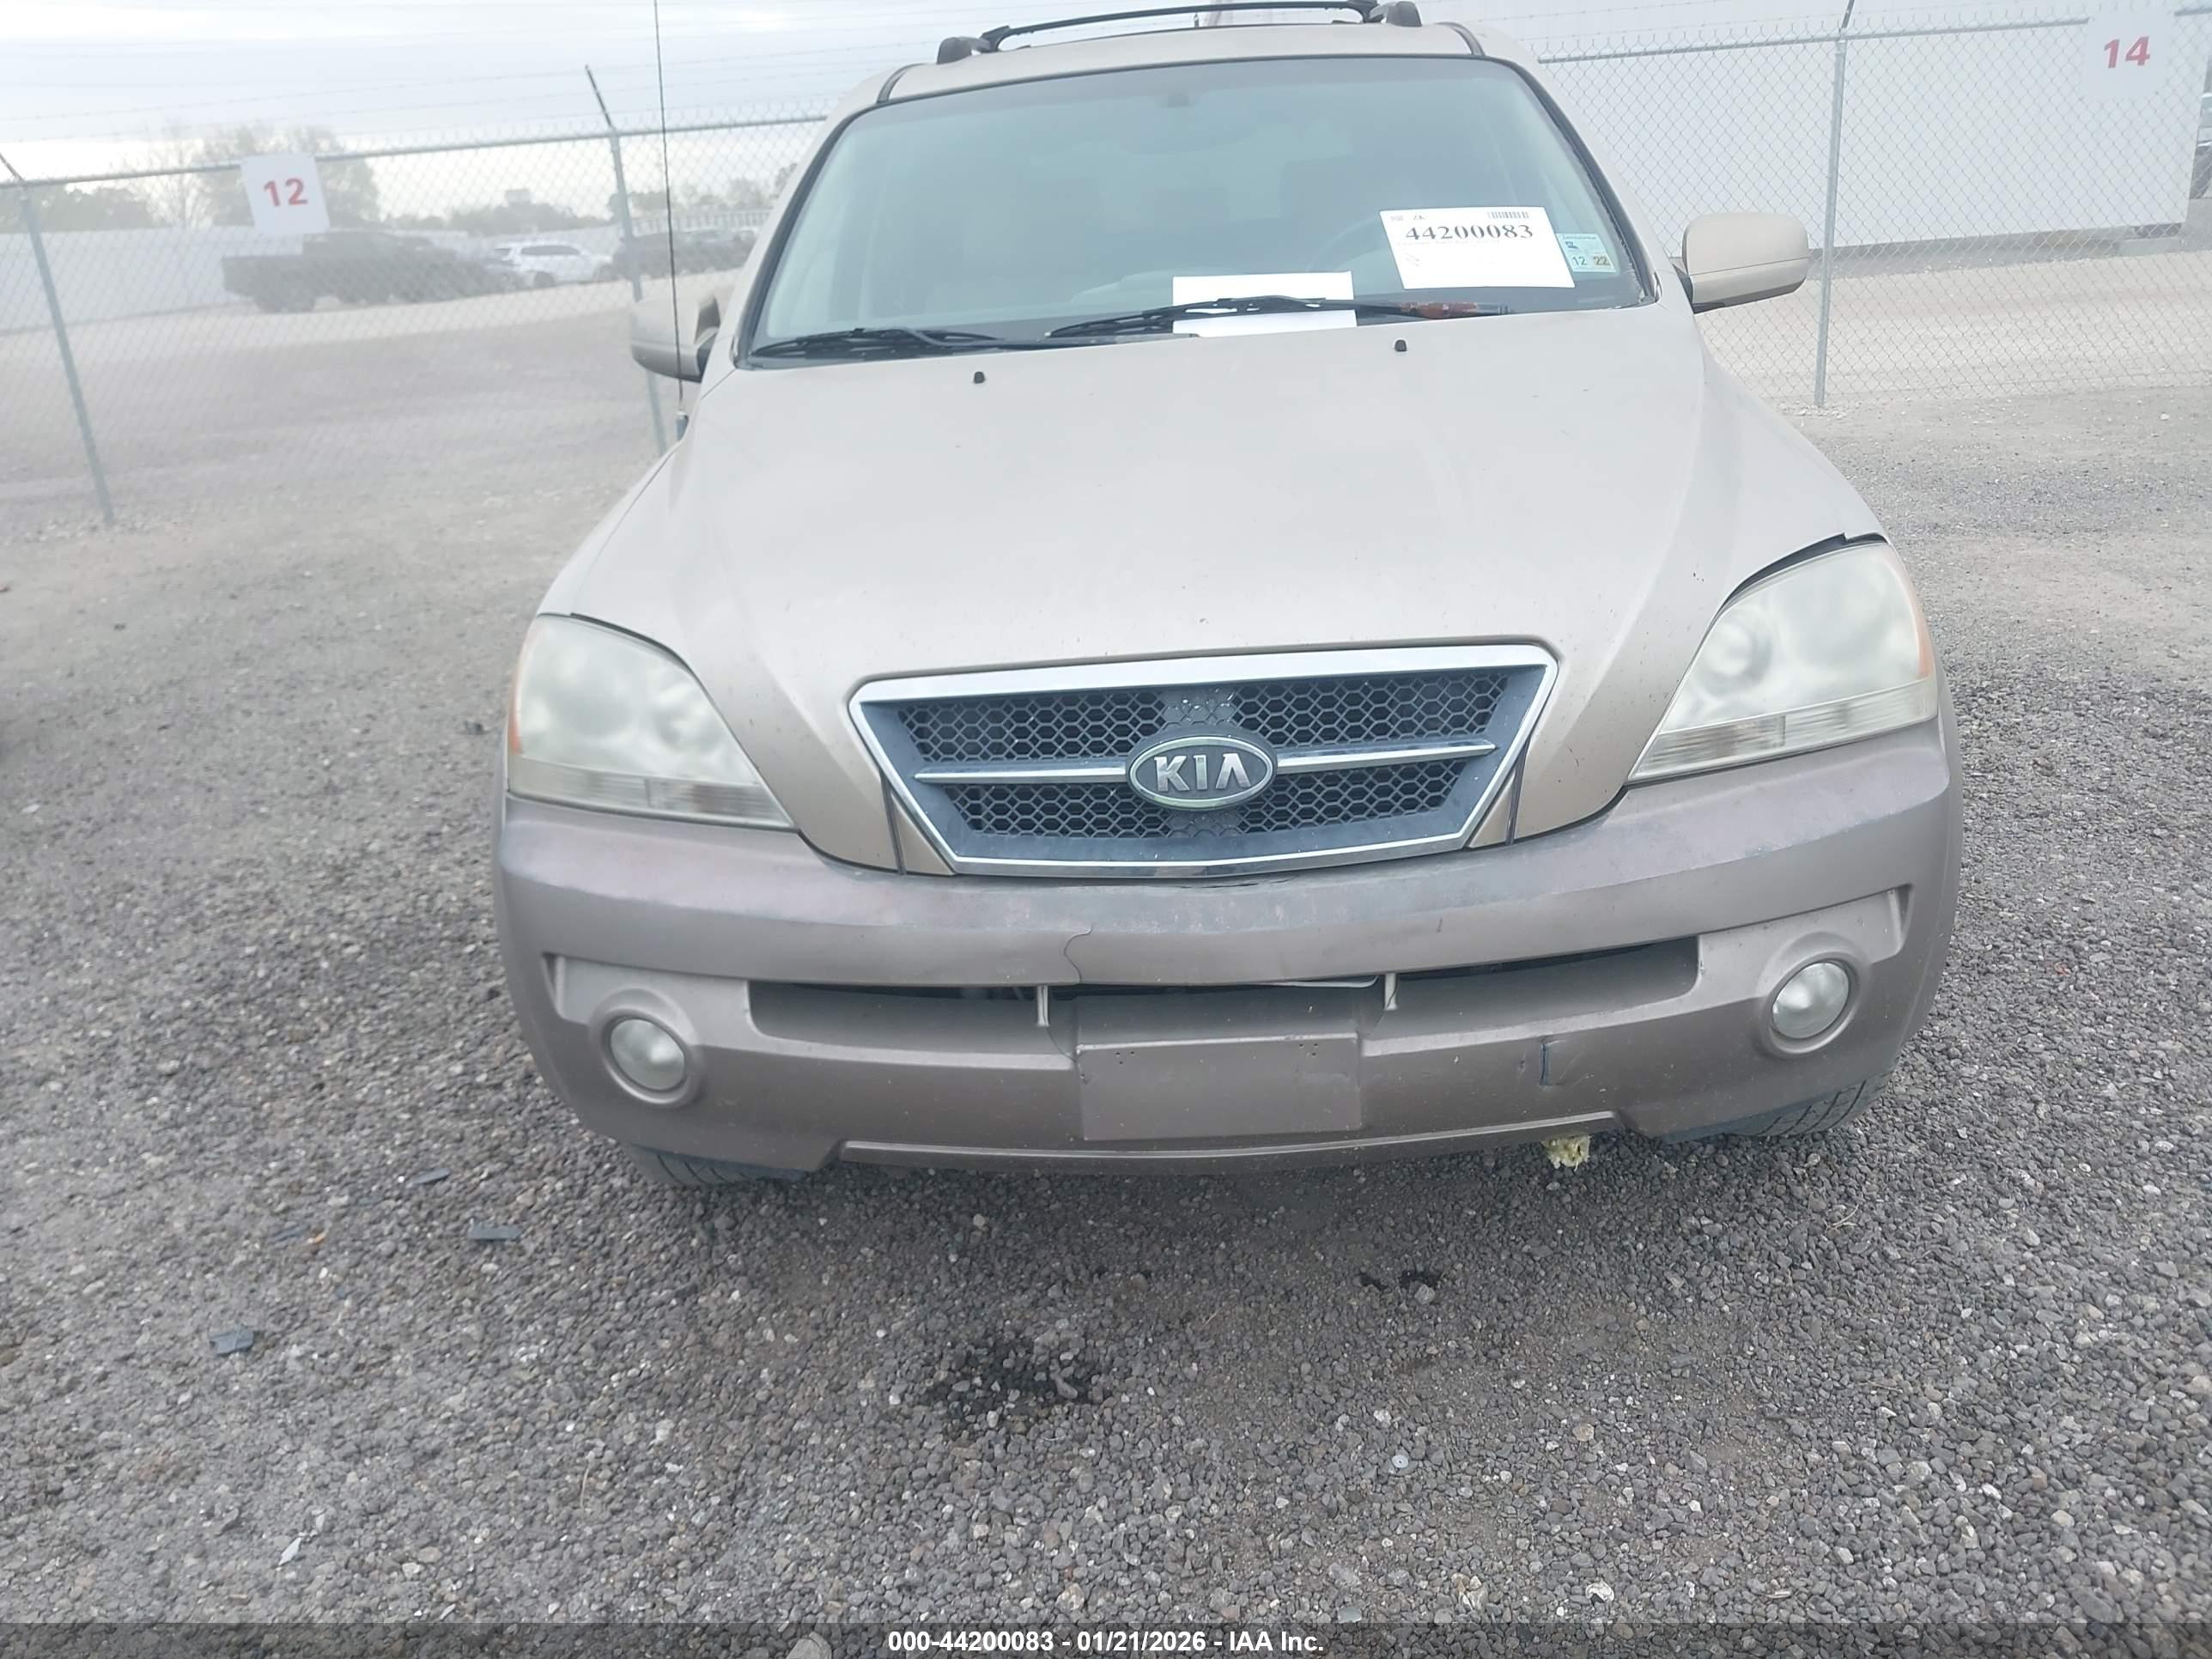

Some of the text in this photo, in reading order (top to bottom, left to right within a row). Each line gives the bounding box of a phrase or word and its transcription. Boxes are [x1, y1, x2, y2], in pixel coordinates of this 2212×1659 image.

[2103, 35, 2151, 69] 14
[263, 177, 309, 207] 12
[1405, 223, 1534, 241] 44200083
[1571, 255, 1612, 266] 12 22
[1153, 752, 1251, 793] KIA
